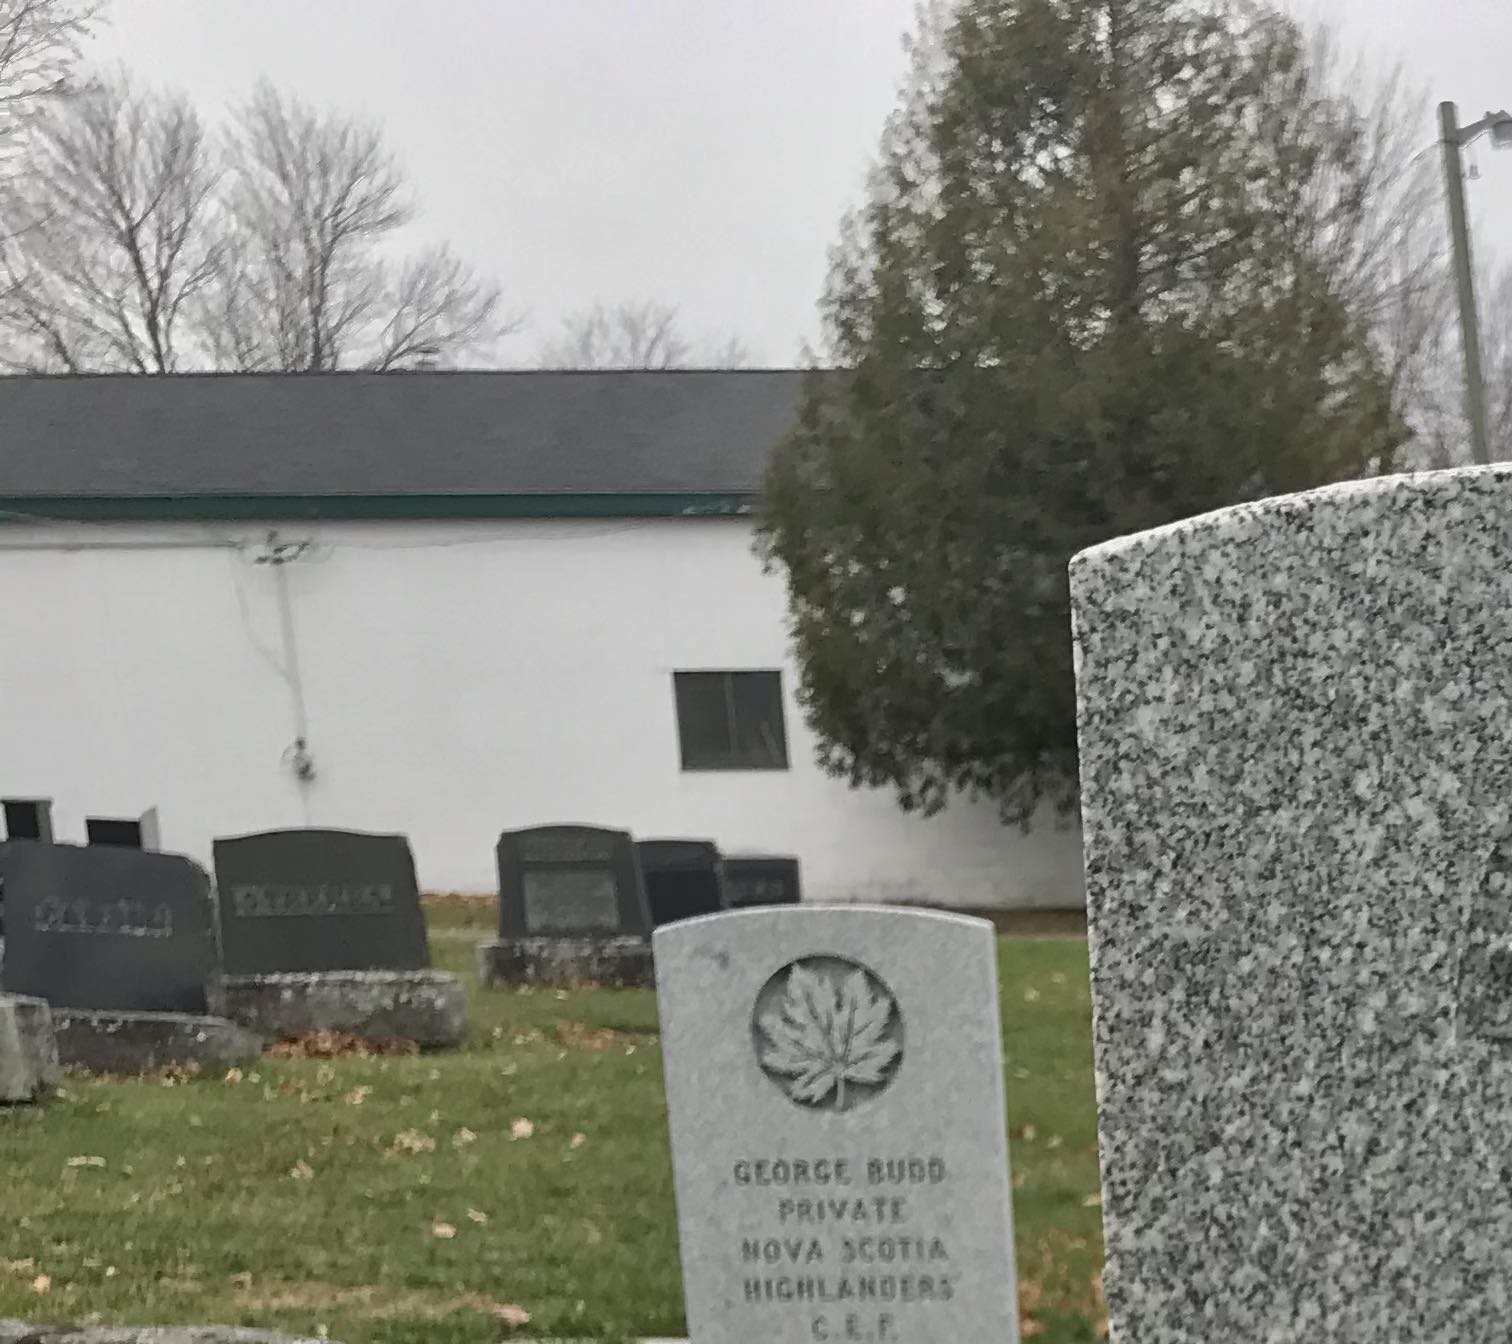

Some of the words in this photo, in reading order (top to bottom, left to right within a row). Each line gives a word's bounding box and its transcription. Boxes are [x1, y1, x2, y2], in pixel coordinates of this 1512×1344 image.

[732, 1158, 853, 1187] GEORGE
[866, 1157, 947, 1185] BUDD
[777, 1197, 906, 1225] PRIVATE
[741, 1238, 825, 1264] NOVA
[841, 1236, 949, 1264] SCOTIA
[743, 1275, 956, 1303] HIGHLANDERS
